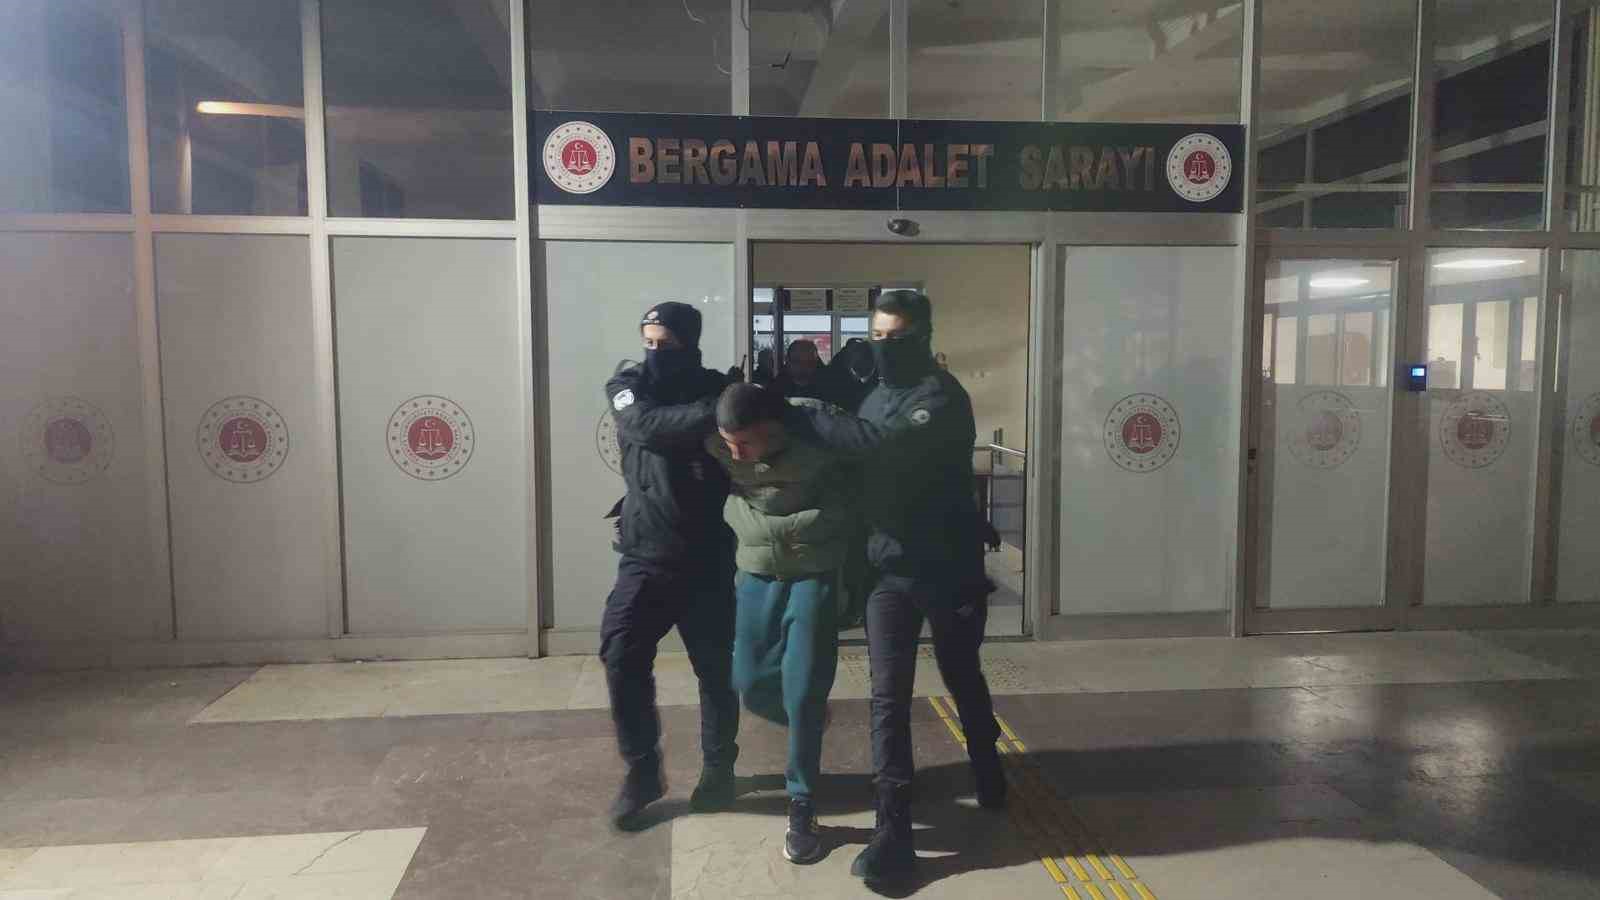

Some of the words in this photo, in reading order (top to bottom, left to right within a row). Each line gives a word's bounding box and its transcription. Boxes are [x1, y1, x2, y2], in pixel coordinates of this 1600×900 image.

[629, 137, 827, 187] BERGAMA
[844, 142, 994, 188] ADALET
[1022, 145, 1154, 191] SARAYI
